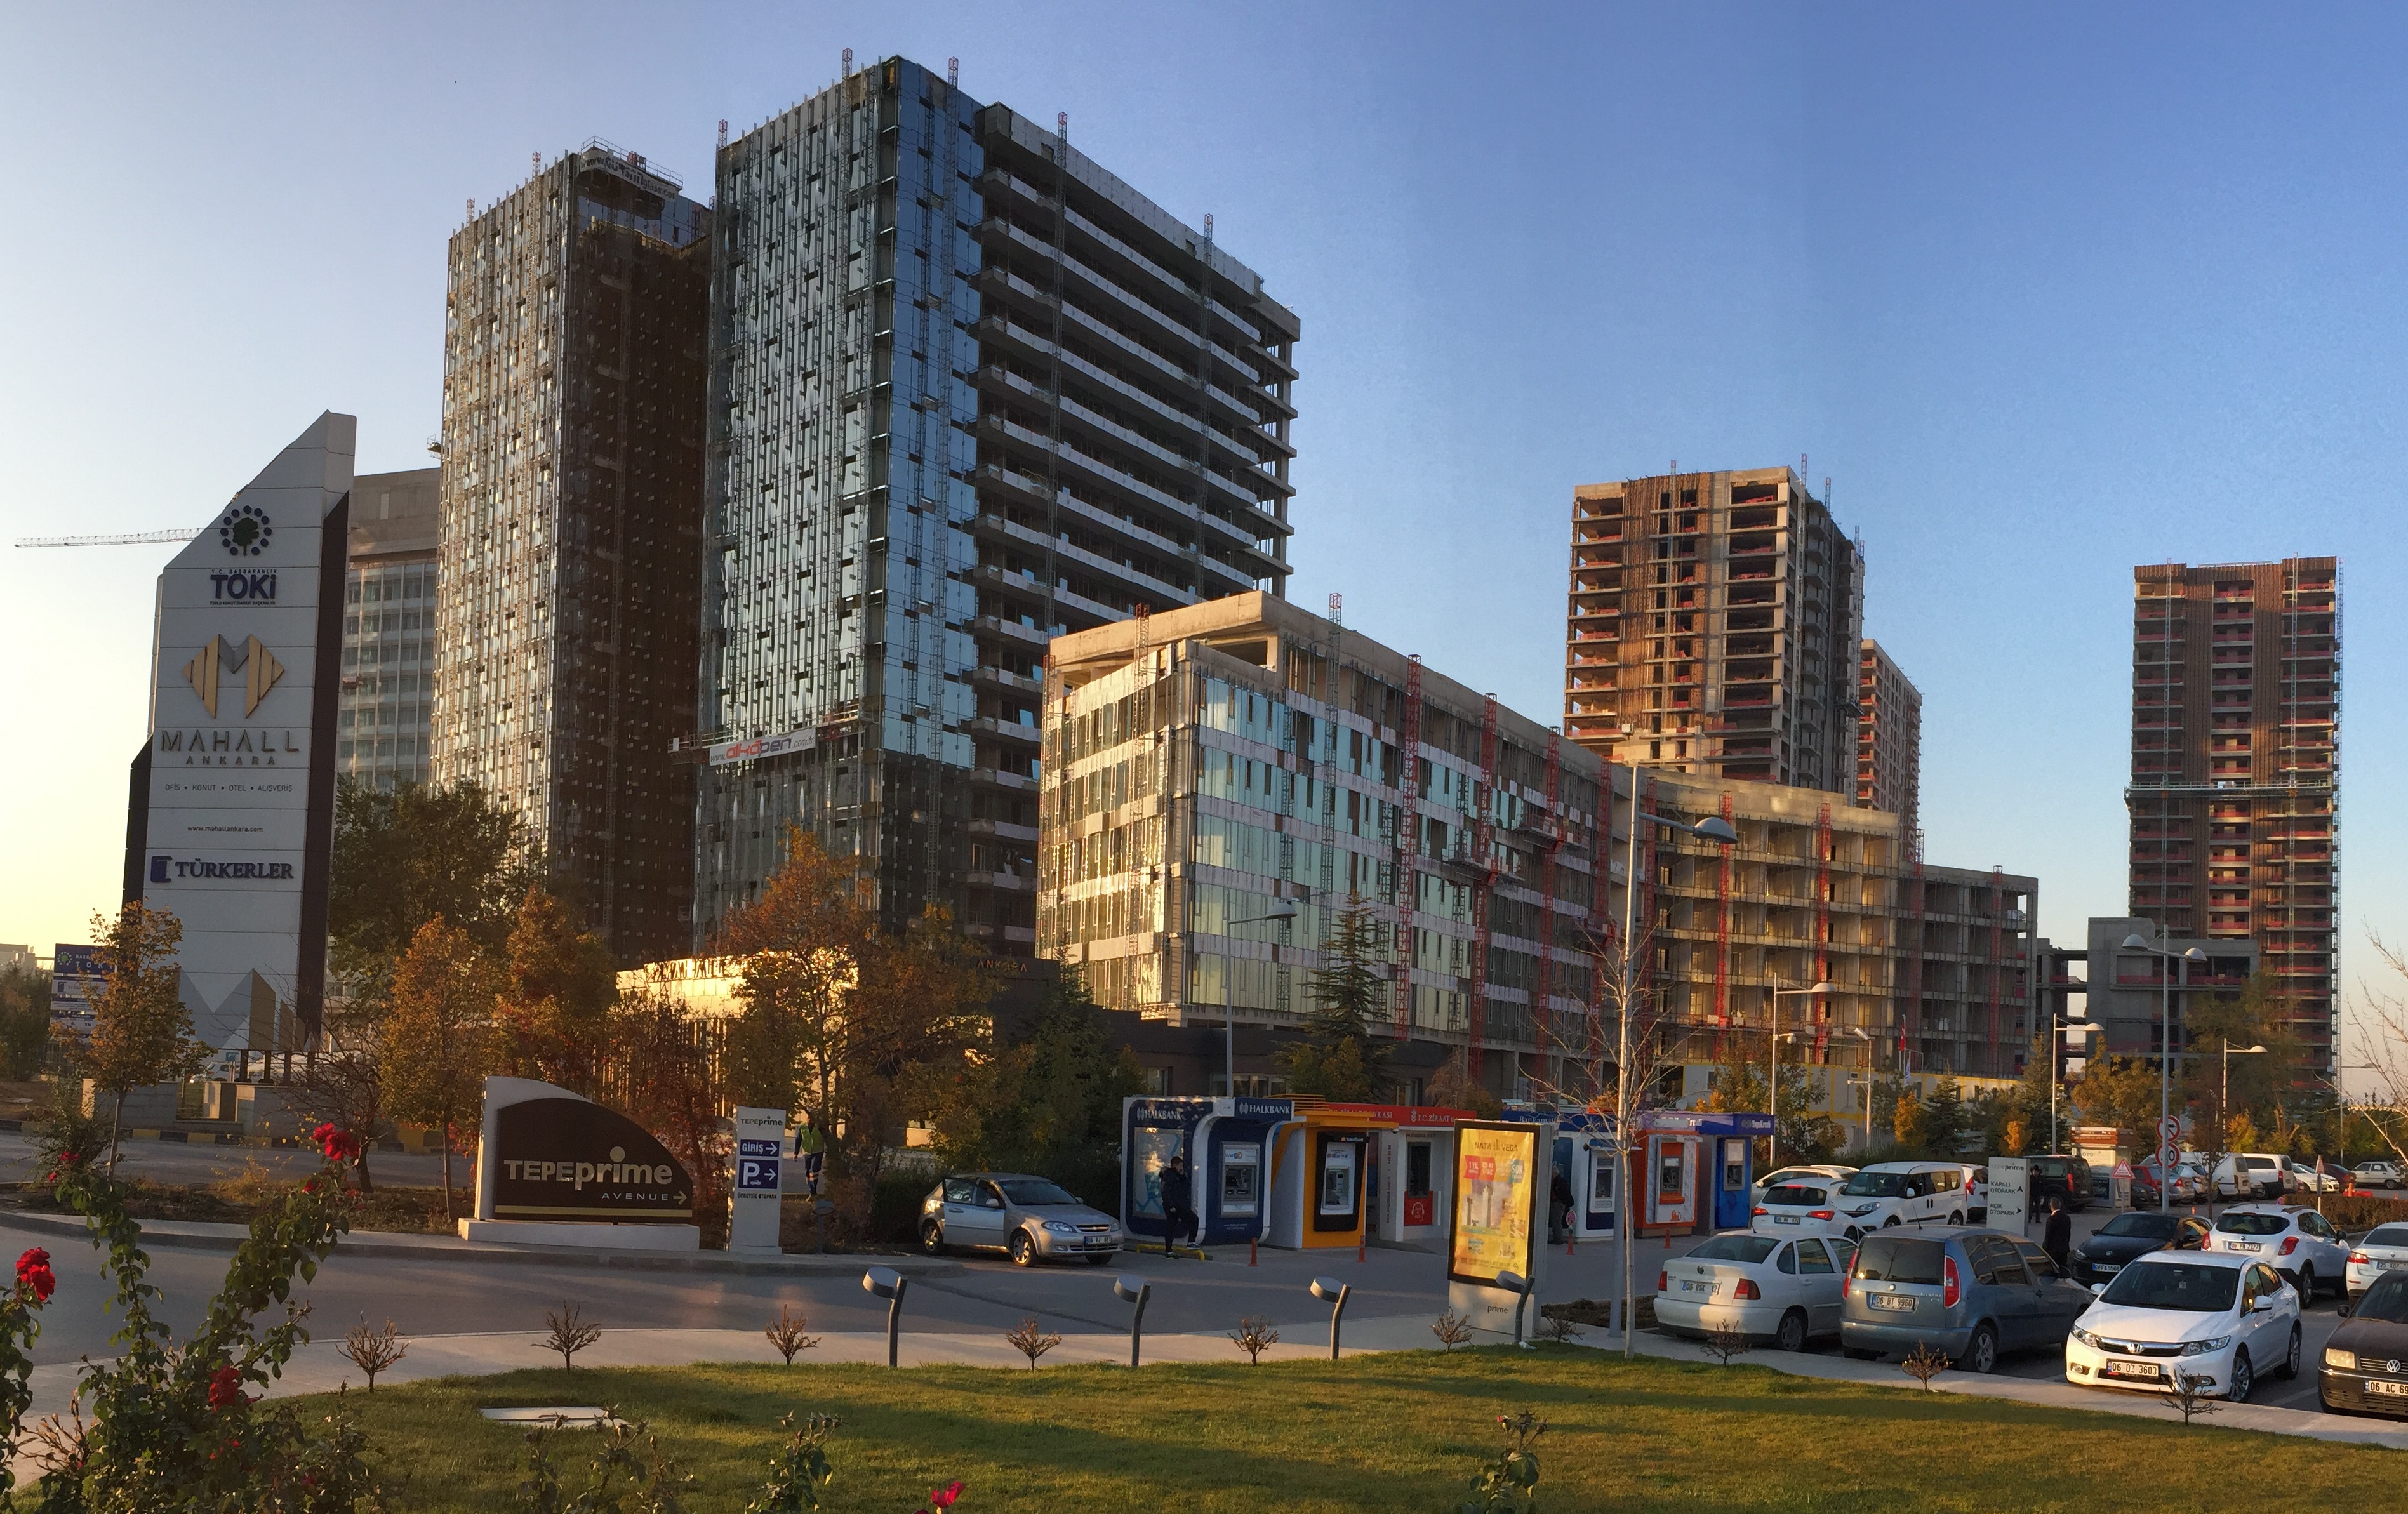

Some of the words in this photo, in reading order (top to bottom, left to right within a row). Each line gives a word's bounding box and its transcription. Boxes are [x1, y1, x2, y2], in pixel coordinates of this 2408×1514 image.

[161, 729, 300, 752] MAHALL
[185, 755, 276, 766] ANKARA
[165, 783, 181, 791] OFİS
[175, 858, 294, 879] TÜRKERLER
[1145, 1109, 1181, 1120] HALKBANK
[1249, 1103, 1290, 1115] HALKBANK
[740, 1115, 783, 1127] TEPEprime
[1428, 1113, 1450, 1122] ZİRAAT
[742, 1141, 764, 1154] GİRİŞ
[1474, 1141, 1492, 1150] NATA
[1501, 1143, 1519, 1152] VEGA
[503, 1146, 673, 1192] TEPEprime
[742, 1162, 761, 1186] P
[1512, 1164, 1524, 1174] SON
[601, 1192, 669, 1201] AVENUE
[1876, 1296, 1884, 1305] 06
[1887, 1297, 1895, 1306] BT
[2112, 1362, 2122, 1372] 06
[2138, 1365, 2157, 1376] 3603
[2370, 1381, 2381, 1391] 06
[2385, 1383, 2396, 1393] AC
